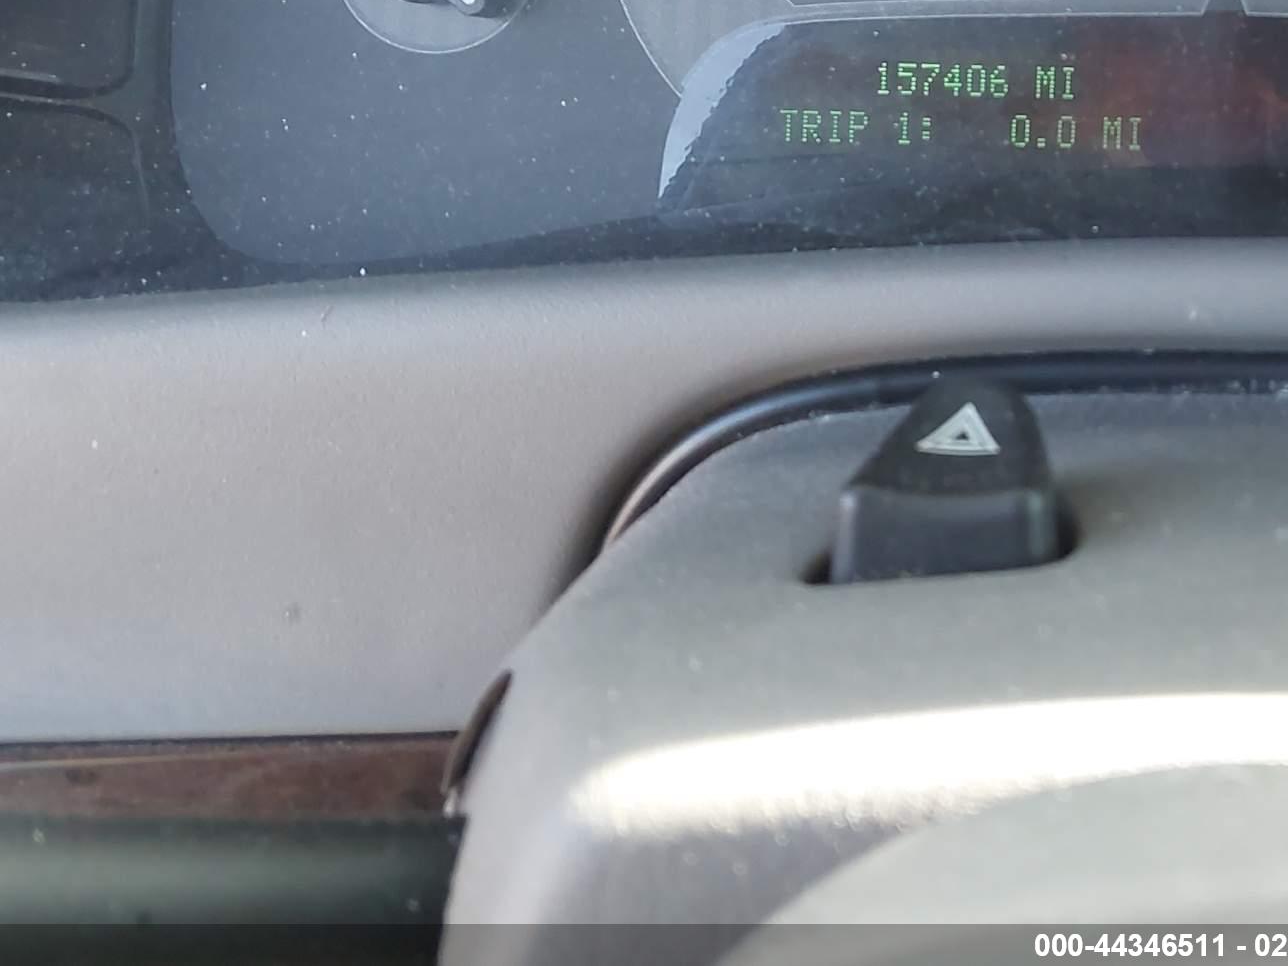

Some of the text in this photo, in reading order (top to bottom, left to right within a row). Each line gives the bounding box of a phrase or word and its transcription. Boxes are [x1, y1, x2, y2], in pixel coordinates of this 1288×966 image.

[877, 62, 1076, 99] 157406 MI
[780, 109, 1143, 151] TRIP 1: 0.0 MI
